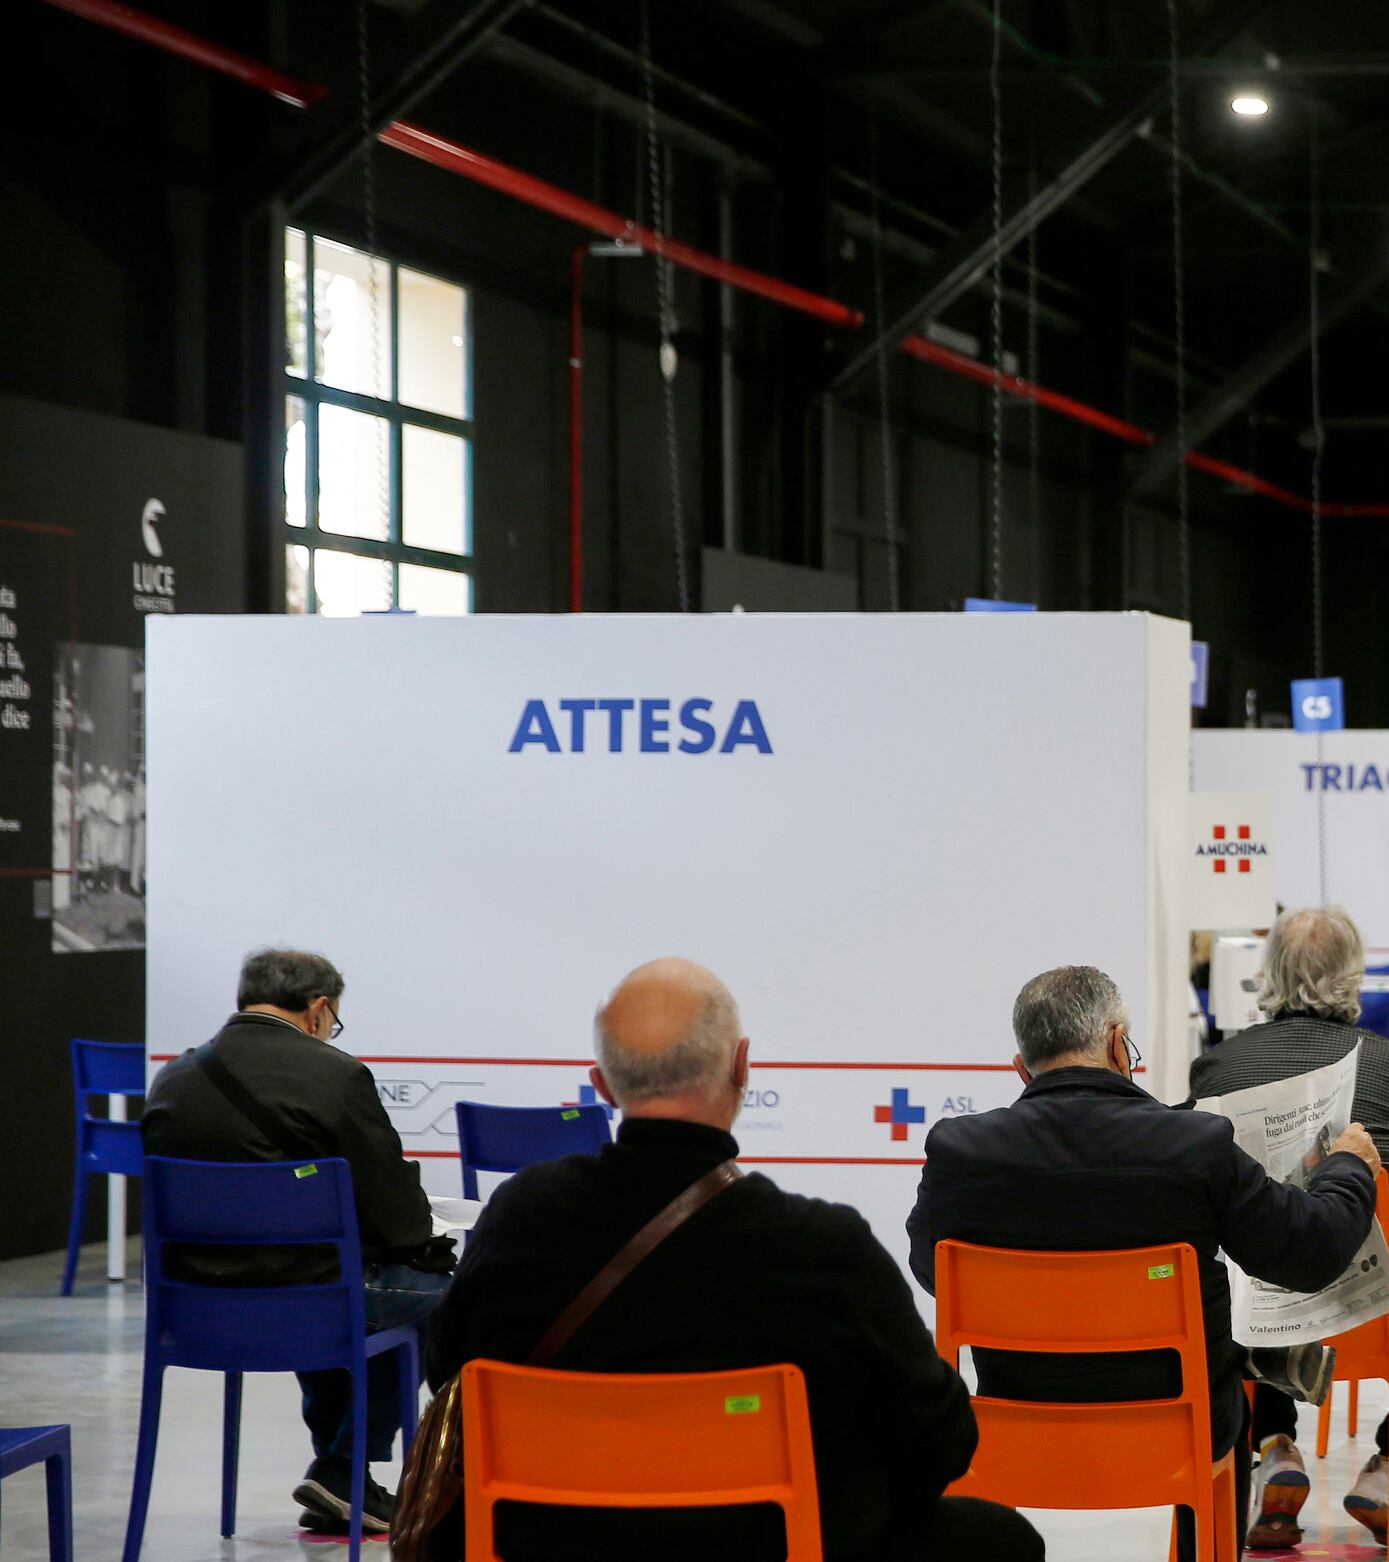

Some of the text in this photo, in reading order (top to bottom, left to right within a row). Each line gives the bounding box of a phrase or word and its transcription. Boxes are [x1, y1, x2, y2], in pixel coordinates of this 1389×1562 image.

[133, 561, 175, 595] LUCE
[508, 698, 773, 754] ATTESA
[1196, 843, 1267, 856] AMUCHINA
[743, 1090, 779, 1107] ZIO
[942, 1096, 977, 1113] ASL
[1266, 1127, 1283, 1138] fuga
[1250, 1323, 1301, 1334] Valentino
